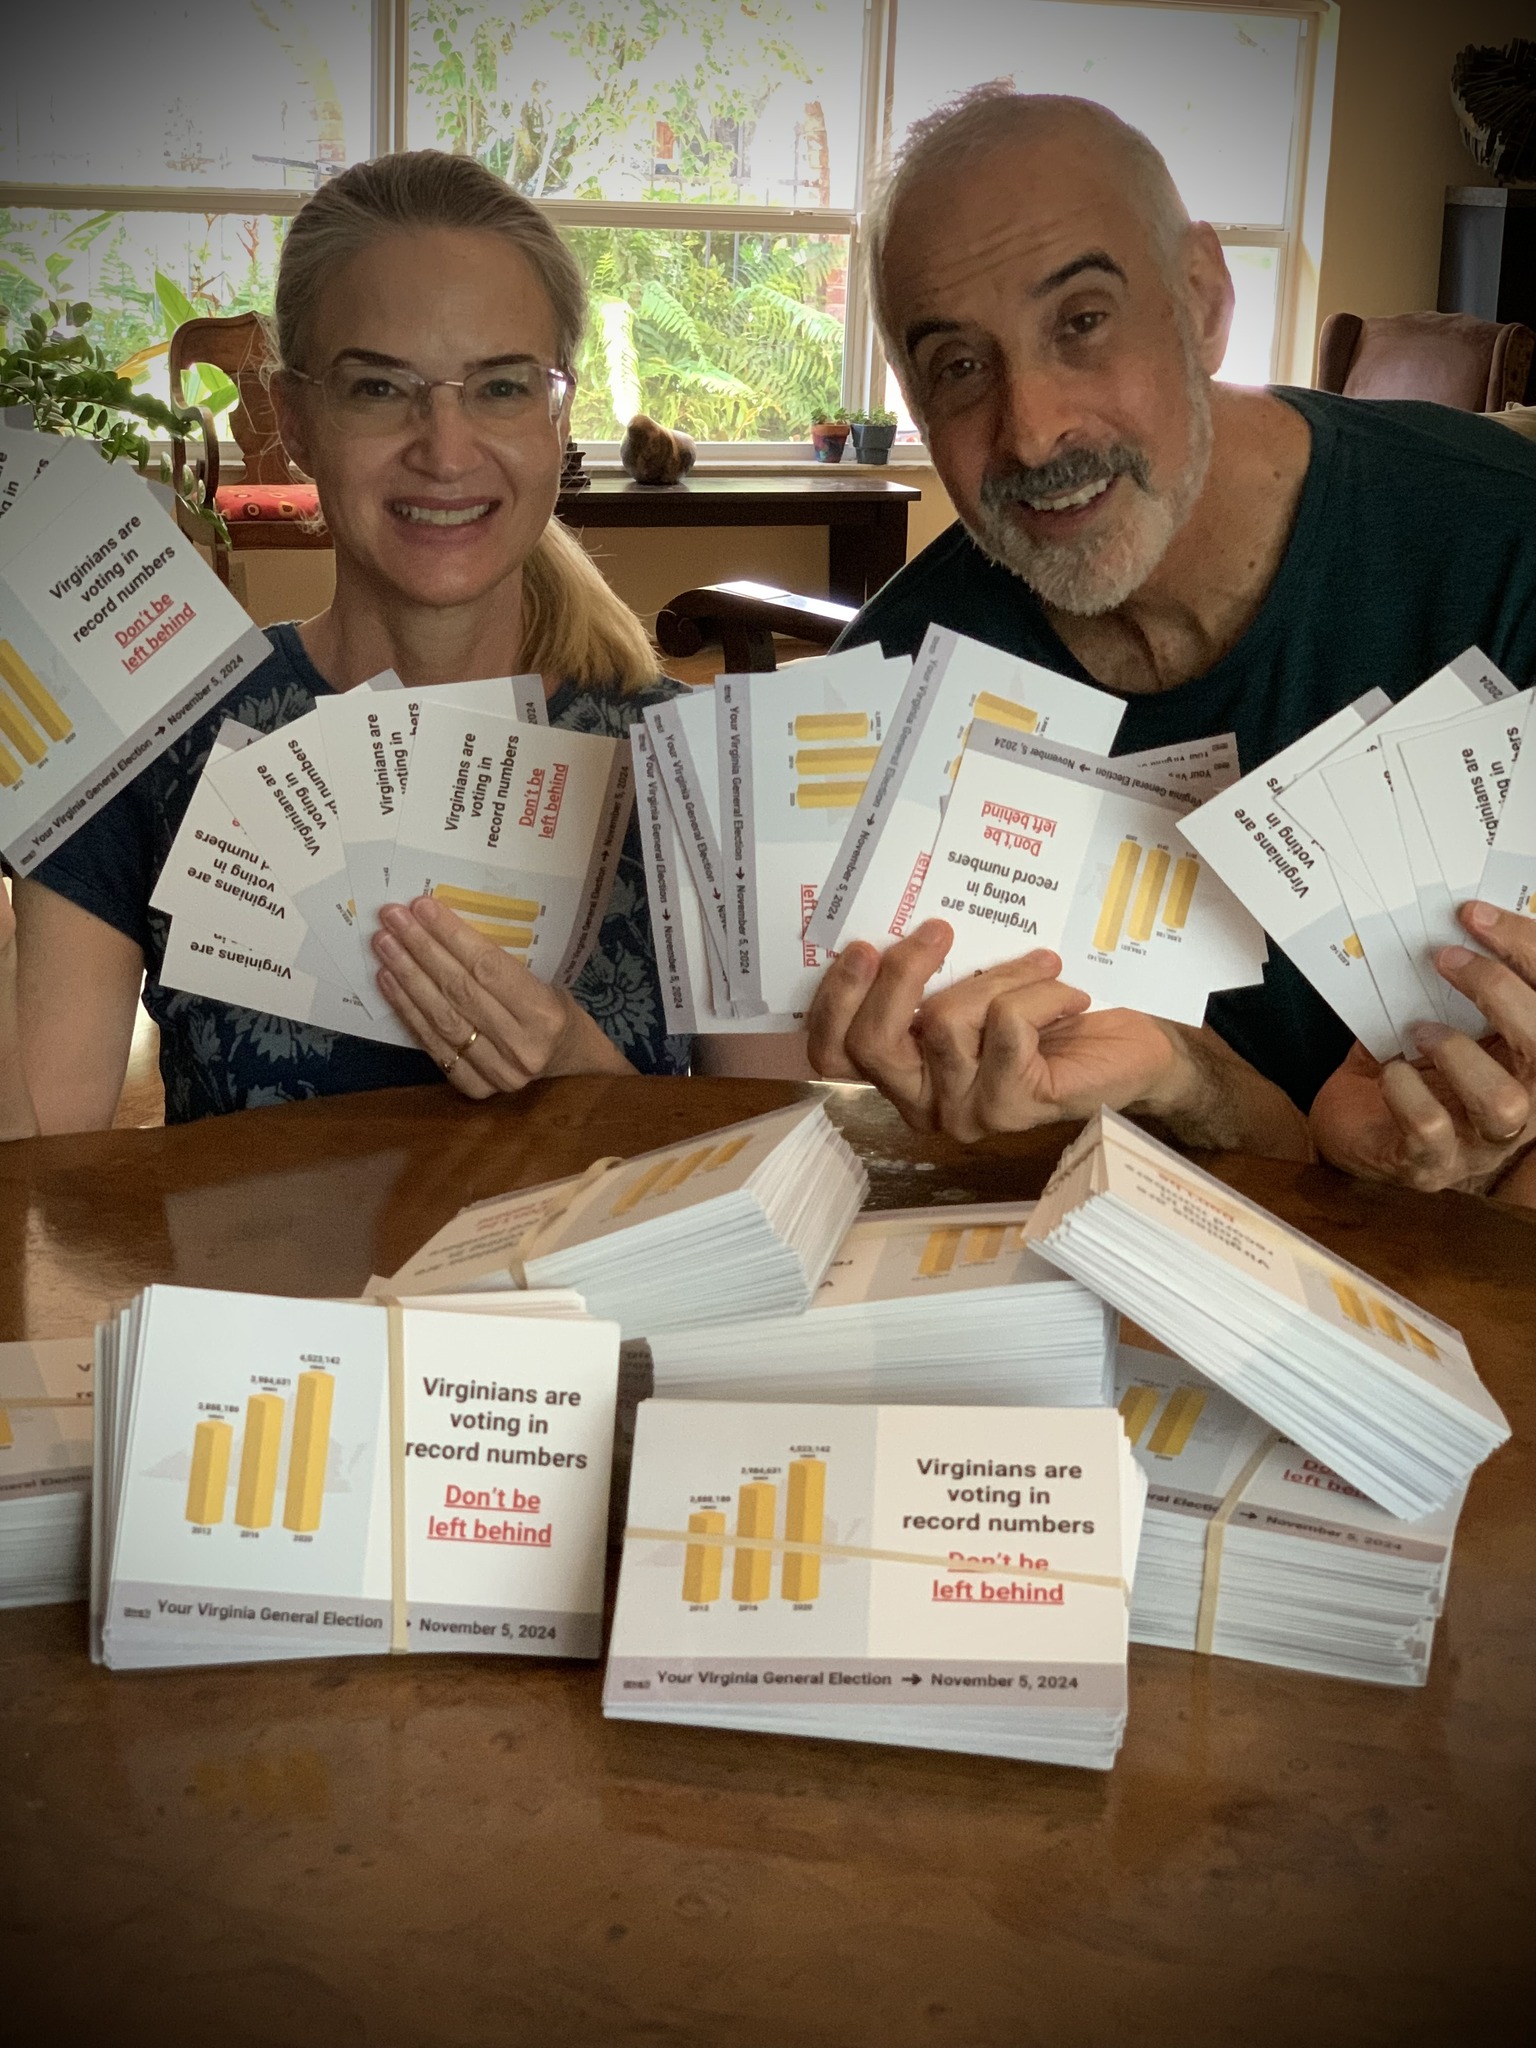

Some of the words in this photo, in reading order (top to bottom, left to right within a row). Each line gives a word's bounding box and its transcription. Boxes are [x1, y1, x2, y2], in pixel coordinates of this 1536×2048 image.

[3, 481, 19, 497] in
[49, 537, 118, 600] Virginians
[118, 515, 142, 540] are
[81, 563, 125, 603] voting
[123, 548, 139, 565] in
[73, 597, 118, 643] record
[117, 546, 176, 603] numbers
[114, 609, 154, 649] Don't
[155, 593, 175, 618] be
[121, 642, 149, 675] left
[146, 602, 197, 656] behind
[923, 660, 938, 683] Your
[1479, 675, 1503, 699] 2024
[730, 706, 739, 731] Your
[906, 685, 928, 724] Virginia
[367, 713, 381, 738] are
[389, 731, 403, 745] in
[32, 827, 54, 847] Your
[53, 798, 87, 829] Virginia
[85, 770, 119, 801] General
[117, 738, 153, 772] Election
[167, 684, 212, 726] November
[220, 654, 244, 677] 2024
[729, 734, 741, 775] Virginia
[890, 726, 912, 766] General
[994, 737, 1018, 751] 2024
[1030, 747, 1075, 769] November
[288, 740, 332, 799] numbers
[394, 749, 408, 795] oting
[646, 754, 656, 778] Your
[1462, 748, 1479, 773] are
[1490, 761, 1505, 777] in
[257, 764, 277, 788] are
[285, 771, 300, 788] in
[373, 741, 394, 816] Virginians
[444, 759, 471, 832] Virginians
[462, 732, 477, 757] are
[470, 775, 492, 818] voting
[481, 756, 493, 772] in
[873, 767, 895, 808] Election
[1095, 766, 1131, 787] Election
[1131, 778, 1167, 797] General
[487, 801, 506, 848] record
[497, 735, 519, 800] numbers
[518, 790, 540, 828] Don't
[533, 767, 546, 788] be
[538, 811, 560, 840] left
[549, 763, 569, 812] behind
[603, 802, 622, 847] November
[617, 765, 629, 790] 2024
[647, 781, 658, 821] Virginia
[732, 777, 742, 818] General
[273, 788, 320, 857] Virginians
[296, 786, 327, 830] voting
[665, 734, 677, 758] Your
[673, 760, 690, 800] Virginia
[685, 802, 704, 840] General
[697, 842, 714, 883] Election
[981, 800, 1031, 829] behind
[1234, 808, 1256, 832] are
[1266, 812, 1281, 829] in
[1471, 776, 1499, 846] irginians
[734, 820, 744, 861] Election
[984, 825, 1004, 844] be
[1032, 816, 1057, 837] left
[194, 828, 259, 865] numbers
[652, 823, 664, 861] General
[843, 830, 870, 882] November
[1004, 829, 1043, 857] Don't
[1278, 825, 1315, 869] voting
[187, 866, 212, 884] are
[213, 857, 228, 873] in
[230, 864, 275, 893] voting
[947, 850, 1010, 878] numbers
[1012, 863, 1059, 891] record
[1253, 831, 1309, 898] Virginians
[656, 864, 667, 903] Election
[966, 880, 981, 893] in
[983, 884, 1027, 907] voting
[214, 878, 286, 920] Virginians
[736, 884, 747, 936] November
[826, 894, 843, 920] 2024
[888, 882, 921, 938] behind
[940, 896, 965, 912] are
[967, 903, 1038, 935] Virginians
[190, 941, 214, 955] are
[664, 925, 677, 973] November
[740, 950, 750, 975] 2024
[218, 949, 292, 980] Virginians
[672, 986, 684, 1009] 2024
[422, 1376, 538, 1407] Virginians
[545, 1387, 582, 1407] are
[450, 1411, 522, 1437] voting
[528, 1413, 549, 1434] in
[405, 1440, 480, 1463] record
[486, 1446, 588, 1469] numbers
[916, 1458, 1037, 1483] Virginians
[1045, 1463, 1083, 1480] are
[1282, 1469, 1321, 1488] left
[444, 1485, 506, 1512] Don't
[512, 1488, 541, 1513] be
[947, 1486, 1021, 1507] voting
[1028, 1487, 1050, 1504] in
[427, 1516, 468, 1543] left
[474, 1519, 552, 1547] behind
[902, 1512, 981, 1532] record
[988, 1516, 1095, 1535] numbers
[1173, 1496, 1220, 1513] Electio
[1266, 1516, 1341, 1537] November
[1364, 1536, 1402, 1550] 2024
[932, 1580, 974, 1602] left
[980, 1581, 1065, 1605] behind
[157, 1598, 193, 1616] Your
[198, 1602, 256, 1621] Virginia
[260, 1607, 319, 1624] General
[323, 1611, 383, 1629] Election
[419, 1618, 497, 1637] November
[500, 1623, 514, 1640] 5,
[518, 1624, 557, 1640] 2024
[657, 1670, 693, 1684] Your
[698, 1671, 759, 1687] Virginia
[763, 1671, 824, 1685] General
[828, 1671, 892, 1687] Election
[931, 1674, 1013, 1690] November
[1019, 1675, 1033, 1692] 5,
[1038, 1676, 1079, 1690] 2024
